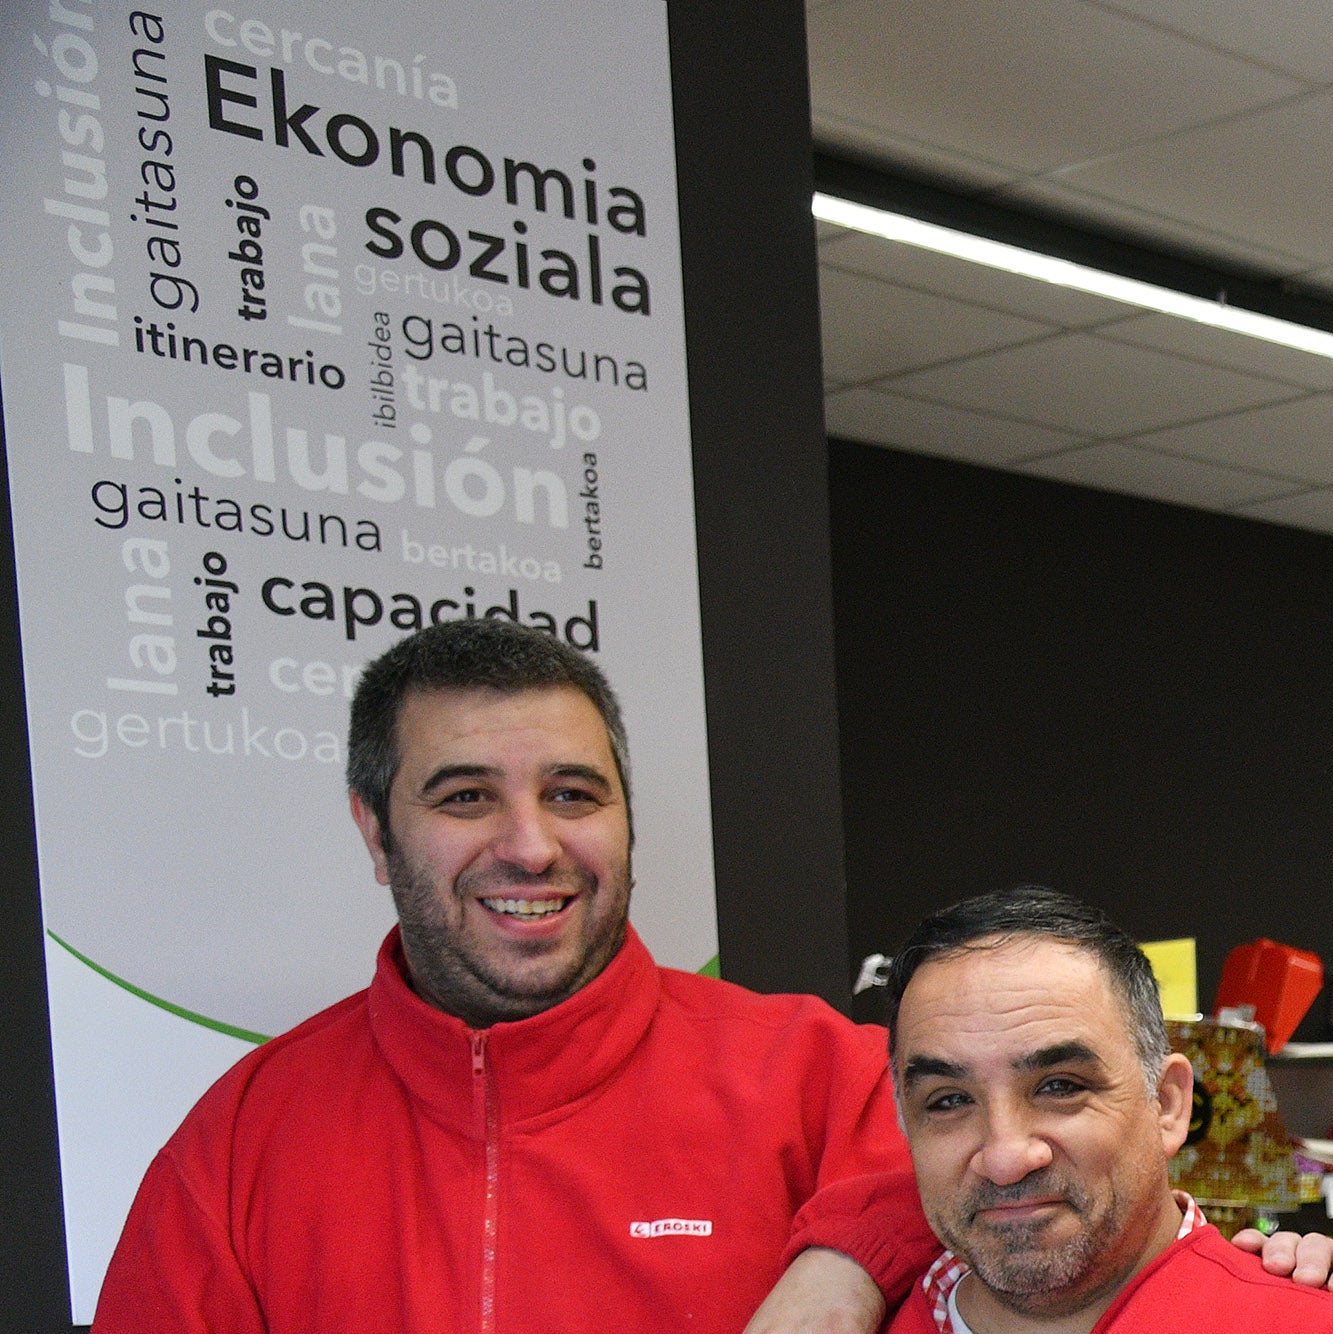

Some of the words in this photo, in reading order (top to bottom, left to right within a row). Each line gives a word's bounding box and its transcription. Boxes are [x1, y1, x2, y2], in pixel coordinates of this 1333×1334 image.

[204, 9, 459, 109] cercanía
[129, 10, 199, 313] gaitasuna
[204, 54, 647, 237] Ekonomia
[225, 175, 271, 321] trabajo
[288, 203, 343, 335] lana
[354, 263, 513, 316] gertukoa
[365, 207, 650, 316] soziala
[133, 316, 346, 389] itinerario
[368, 311, 396, 428] ibilbidea
[402, 315, 648, 391] gaitasuna
[63, 363, 570, 530] Inclusión
[401, 365, 601, 450] trabajo
[91, 478, 382, 552] gaitasuna
[401, 529, 562, 584] bertakoa
[579, 453, 603, 570] bertakoa
[106, 537, 178, 695] lana
[193, 551, 239, 697] trabajo
[261, 576, 600, 653] capacidad
[70, 707, 341, 763] gertukoa
[654, 1222, 708, 1233] EROSKI
